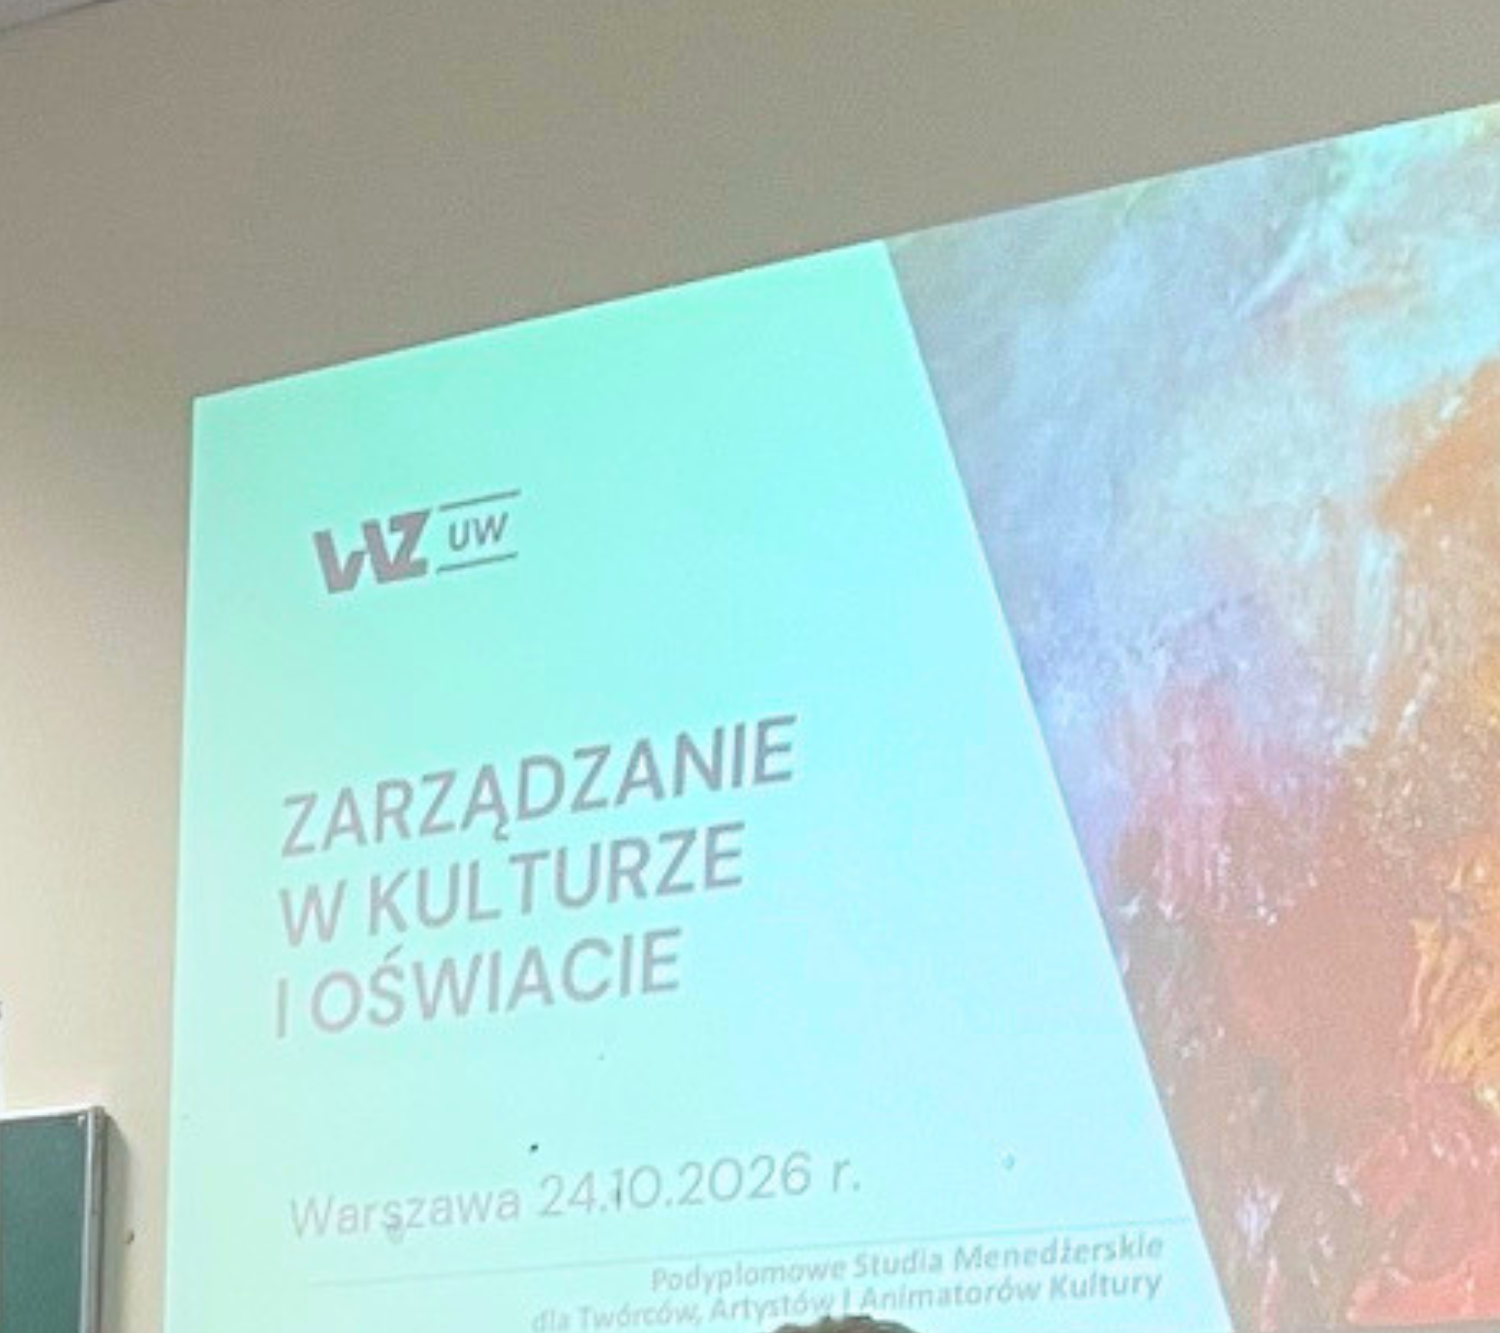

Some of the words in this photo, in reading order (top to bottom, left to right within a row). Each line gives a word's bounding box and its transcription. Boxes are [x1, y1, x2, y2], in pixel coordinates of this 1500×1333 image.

[312, 507, 431, 594] WZ
[449, 512, 509, 551] UW
[281, 714, 797, 858] ZARZĄDZANIE
[280, 879, 347, 947] W
[368, 821, 746, 937] KULTURZE
[276, 978, 288, 1039] I
[310, 927, 682, 1034] OŚWIACIE
[290, 1187, 521, 1238] Warszawa
[538, 1150, 812, 1218] 24.10.2026
[832, 1158, 862, 1193] r.
[531, 1308, 570, 1333] dla
[579, 1297, 703, 1328] Twórców,
[709, 1288, 833, 1325] Artystów
[859, 1275, 1044, 1311] Animatorów
[1049, 1270, 1164, 1299] Kultury
[651, 1256, 847, 1294] Podyplomowe
[854, 1247, 944, 1279] Studia
[954, 1232, 1164, 1272] Menedżerskie
